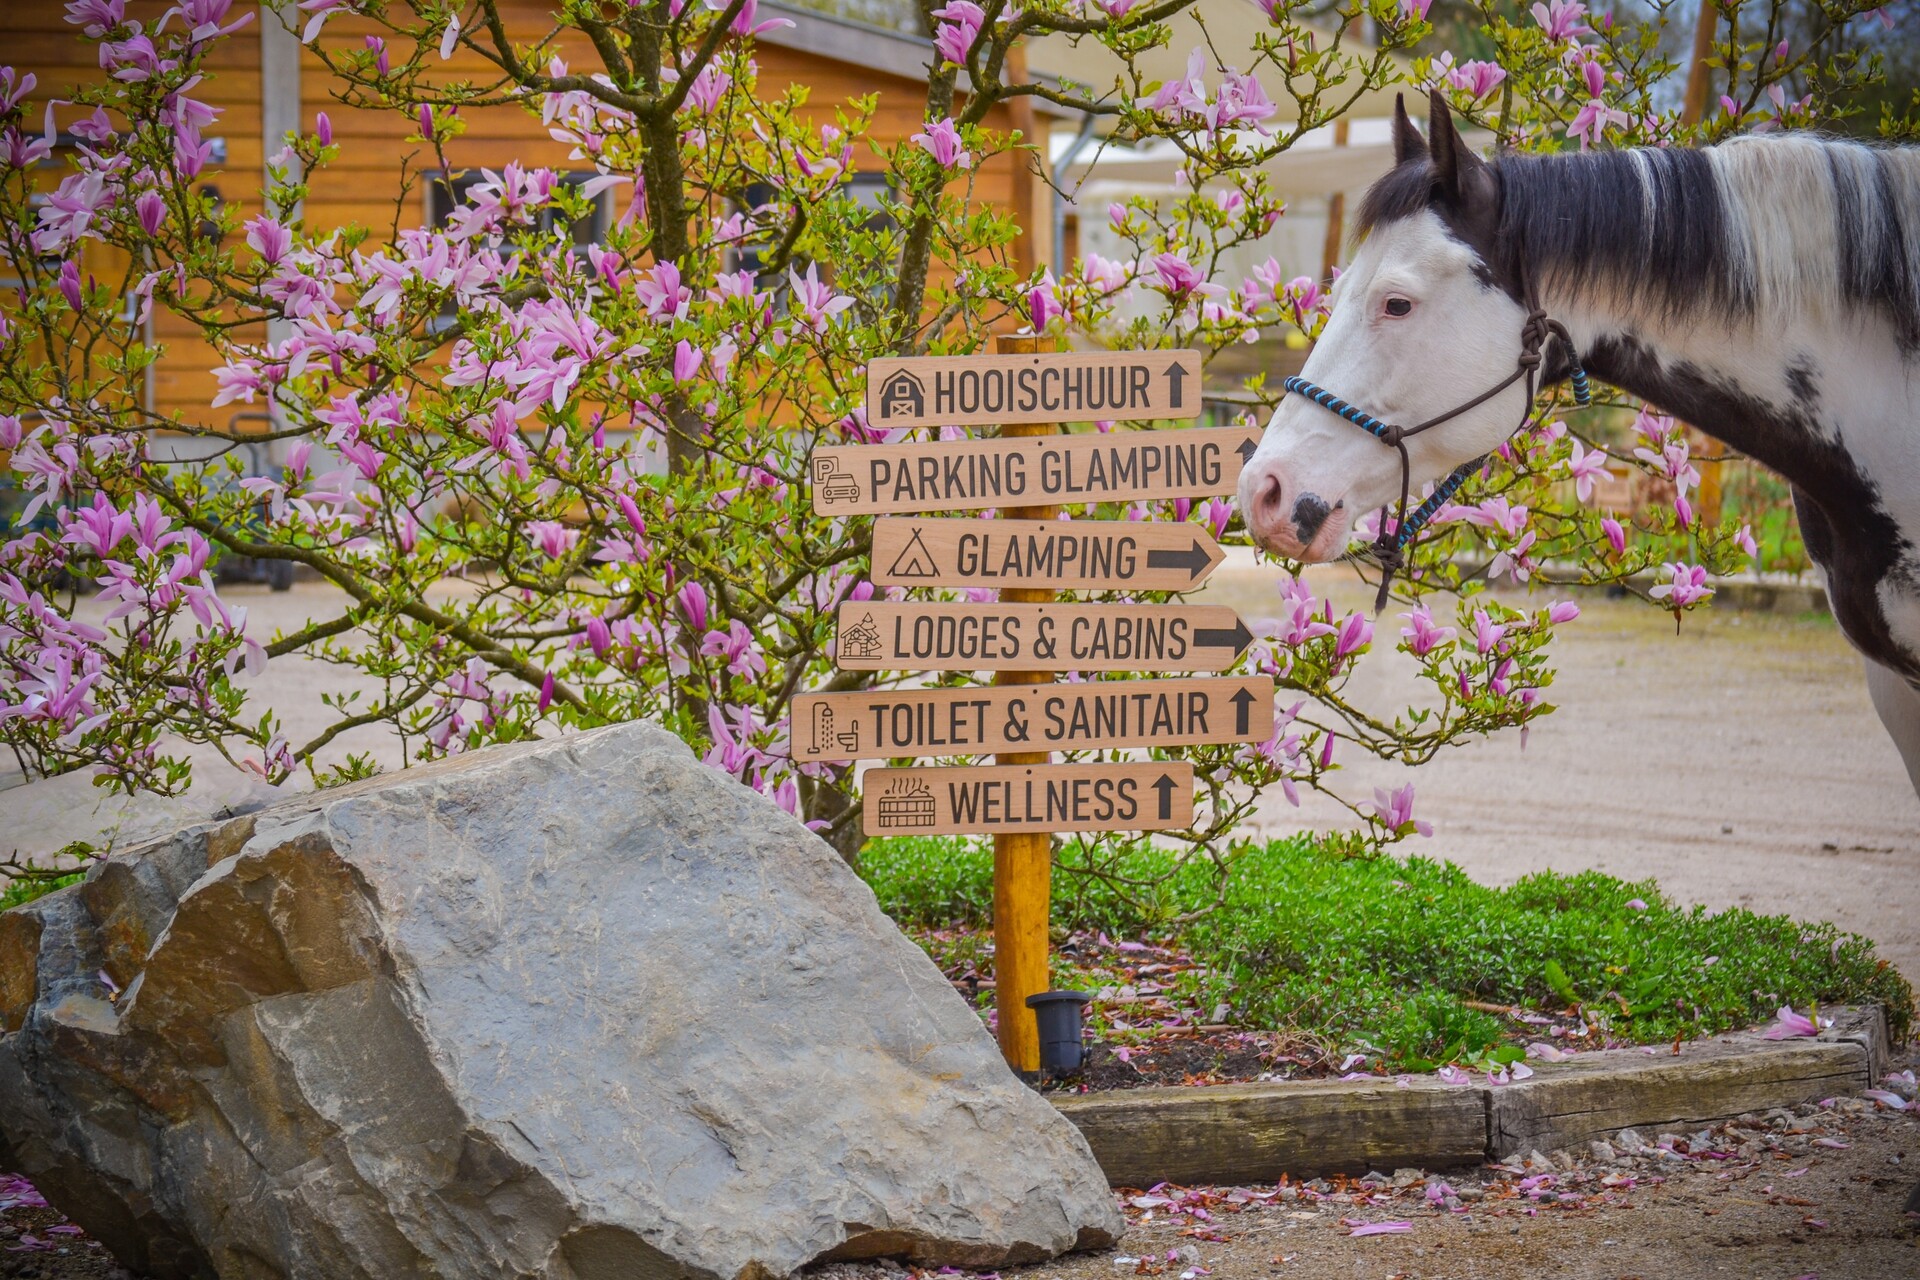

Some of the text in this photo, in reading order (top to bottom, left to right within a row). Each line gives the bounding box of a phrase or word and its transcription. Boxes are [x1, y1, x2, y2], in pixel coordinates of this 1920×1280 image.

[935, 366, 1150, 414] HOOISCHUUR
[870, 443, 1221, 503] PARKING GLAMPING
[957, 533, 1137, 579] GLAMPING
[894, 615, 1187, 661] LODGES & CABINS
[869, 692, 1209, 747] TOILET & SANITAIR
[949, 777, 1138, 824] WELLNESS
